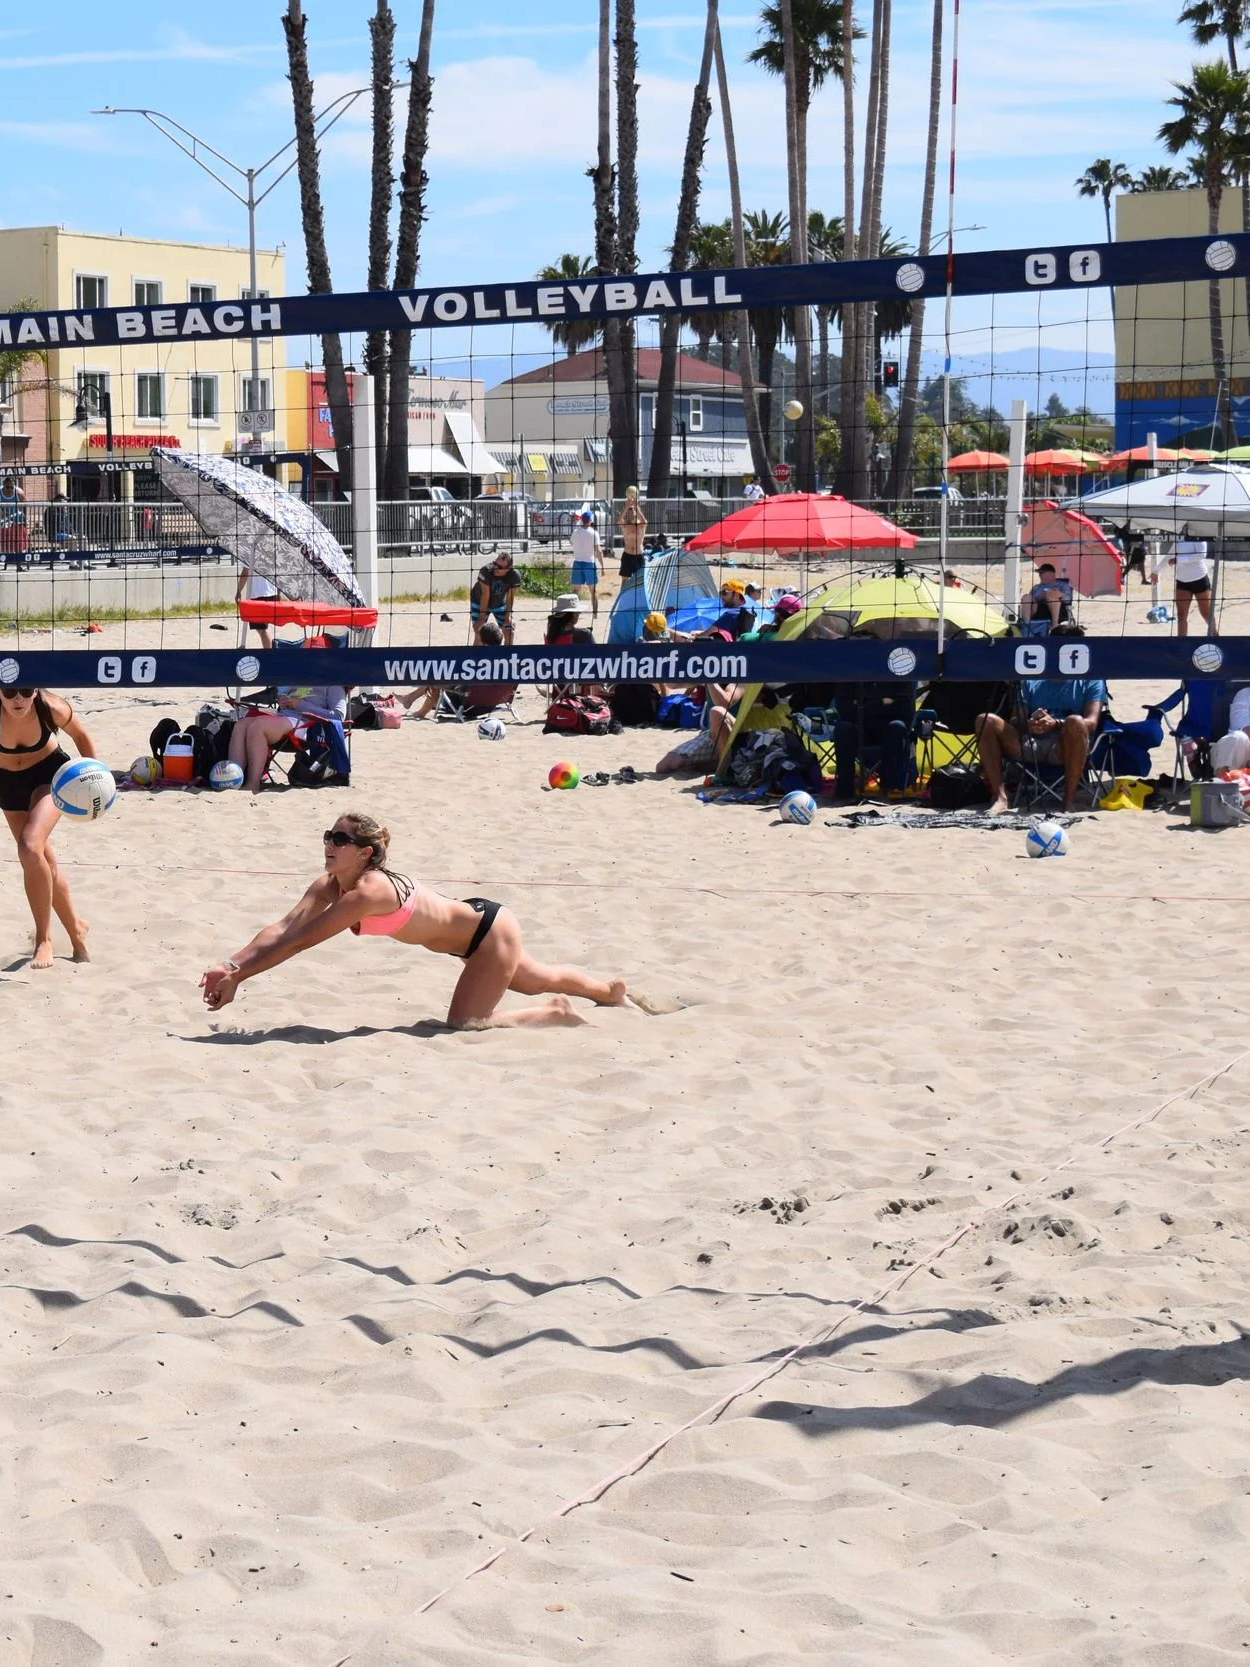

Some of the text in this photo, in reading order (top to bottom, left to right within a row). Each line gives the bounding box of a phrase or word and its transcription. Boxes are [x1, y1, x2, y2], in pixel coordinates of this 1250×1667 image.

[116, 304, 281, 338] BEACH
[398, 276, 742, 322] VOLLEYBALL
[91, 434, 118, 448] SOUH
[31, 465, 71, 474] BEACH
[97, 462, 153, 472] VOLLEYB
[385, 650, 747, 681] www.santacruzwharf.com
[79, 773, 103, 783] Wilson
